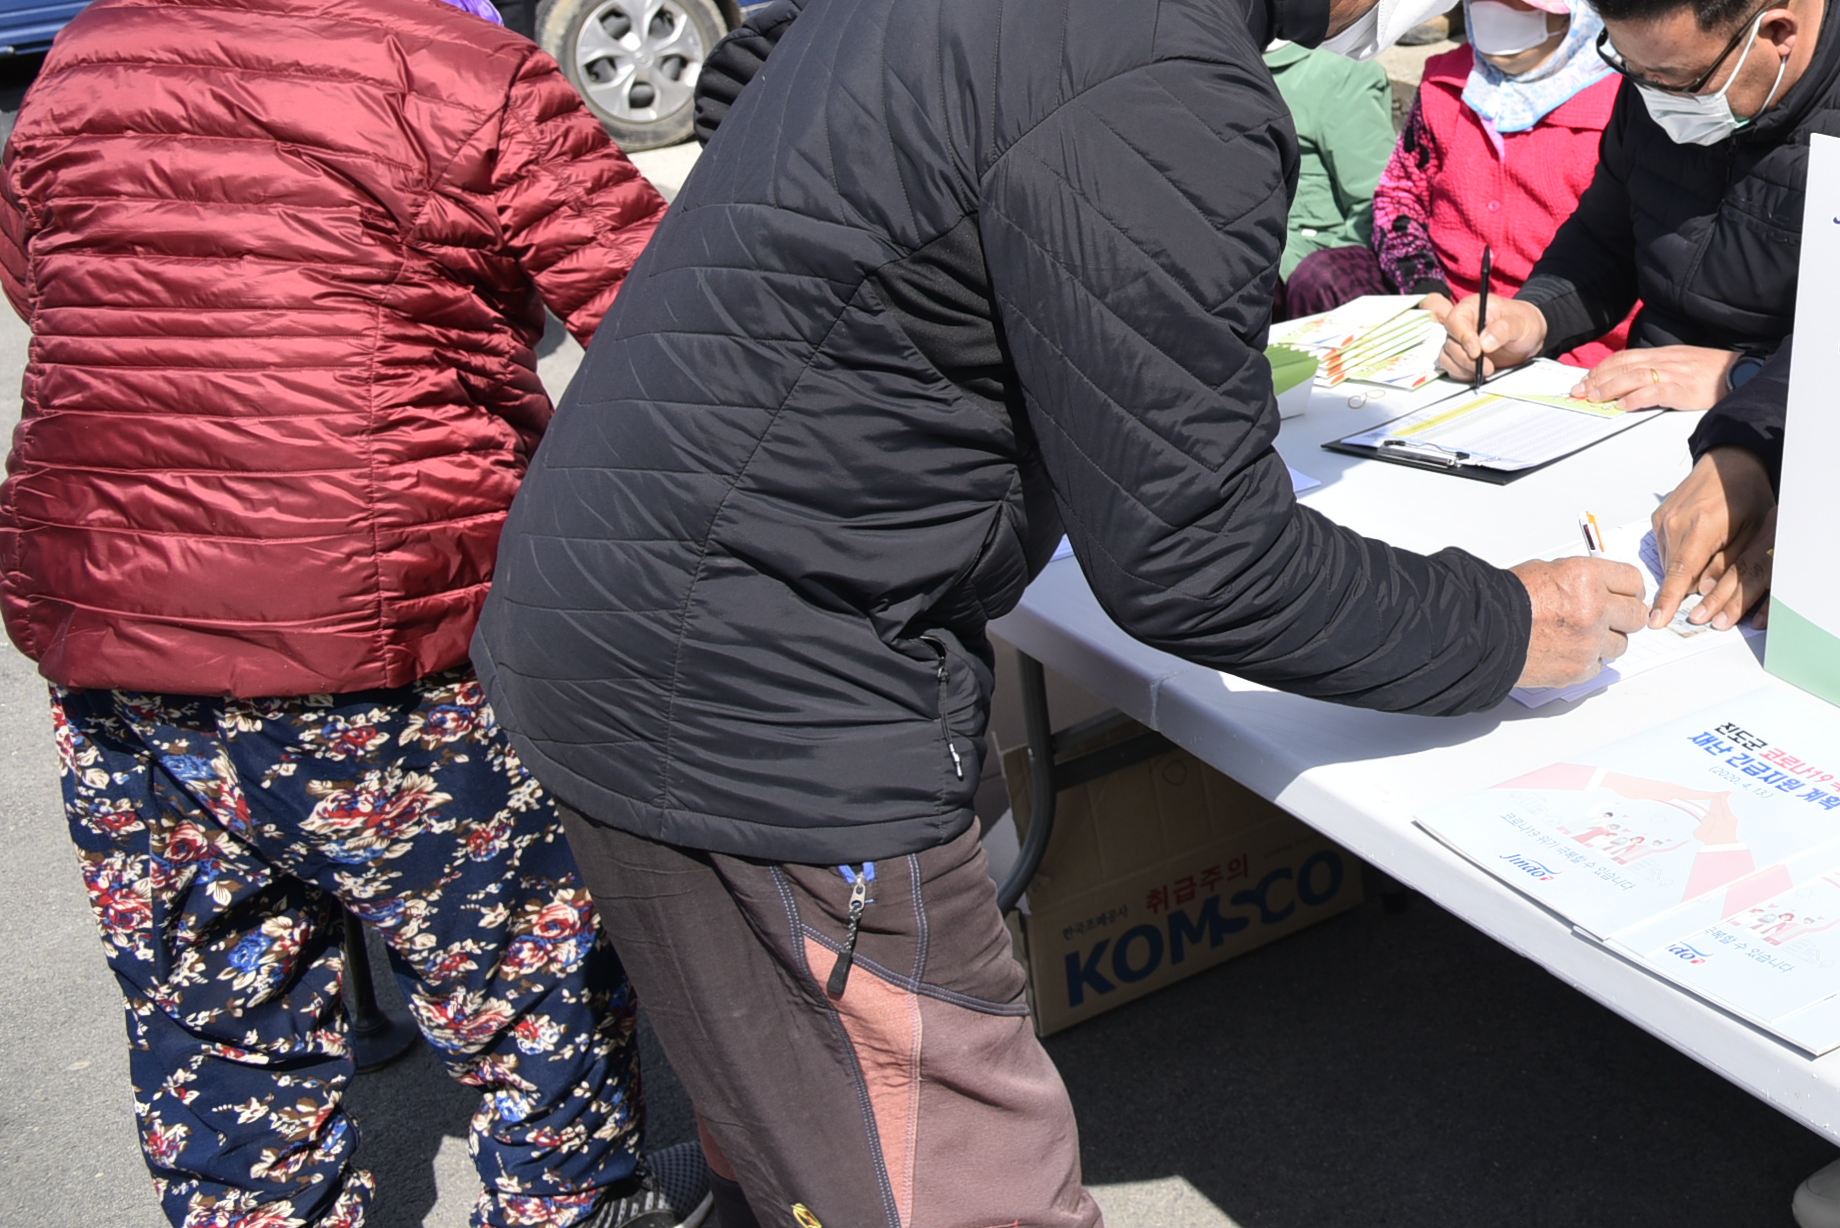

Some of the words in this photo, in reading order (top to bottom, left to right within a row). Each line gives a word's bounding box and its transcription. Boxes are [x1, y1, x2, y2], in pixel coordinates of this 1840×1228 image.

[1686, 731, 1734, 757] 재난
[1725, 752, 1806, 793] 긴급지원
[1714, 722, 1768, 752] 진도군
[1759, 747, 1835, 783] 코로나19
[1500, 812, 1541, 838] 코로나19
[1536, 834, 1561, 850] 위기
[1593, 866, 1636, 891] 있습니다
[1145, 853, 1250, 915] 취급주의
[1063, 849, 1345, 1008] KOMSCO
[1664, 943, 1696, 960] do
[1745, 947, 1796, 973] 있습니다
